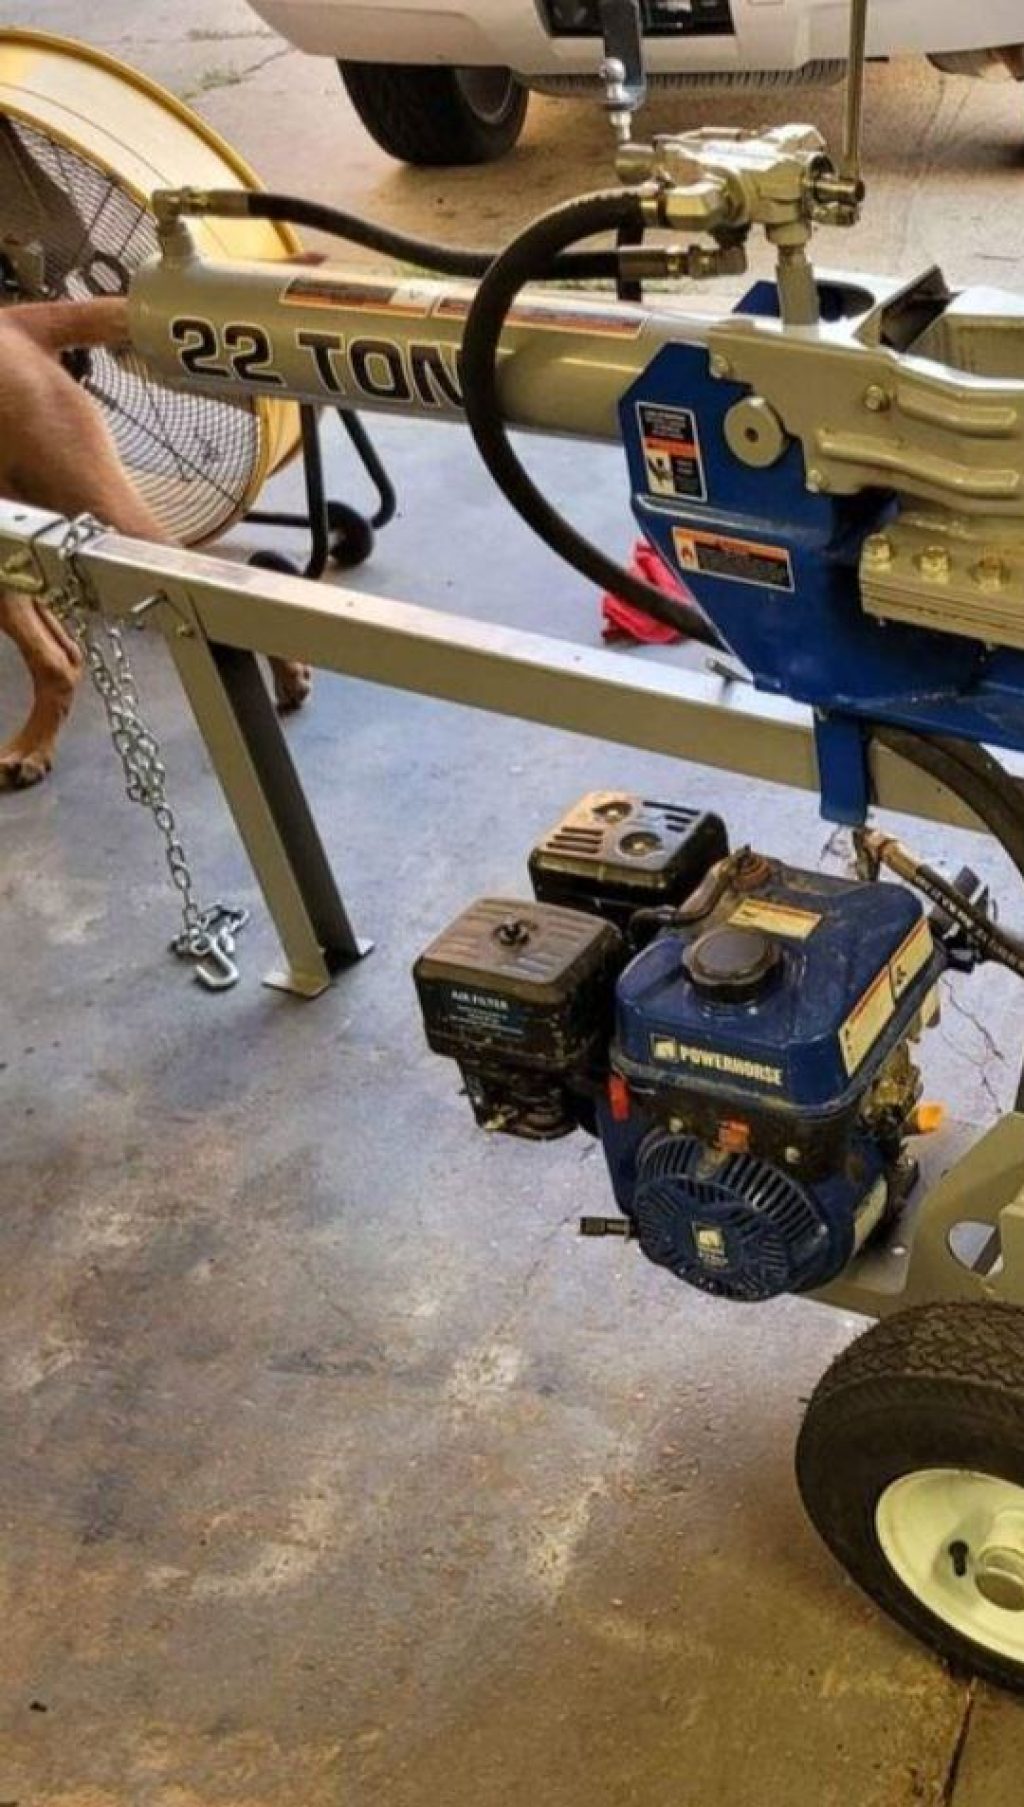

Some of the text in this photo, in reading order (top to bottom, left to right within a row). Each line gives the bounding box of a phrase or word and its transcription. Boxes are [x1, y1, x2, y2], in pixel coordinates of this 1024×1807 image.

[170, 316, 466, 407] 22 TON
[680, 1043, 783, 1087] POWERHORSE
